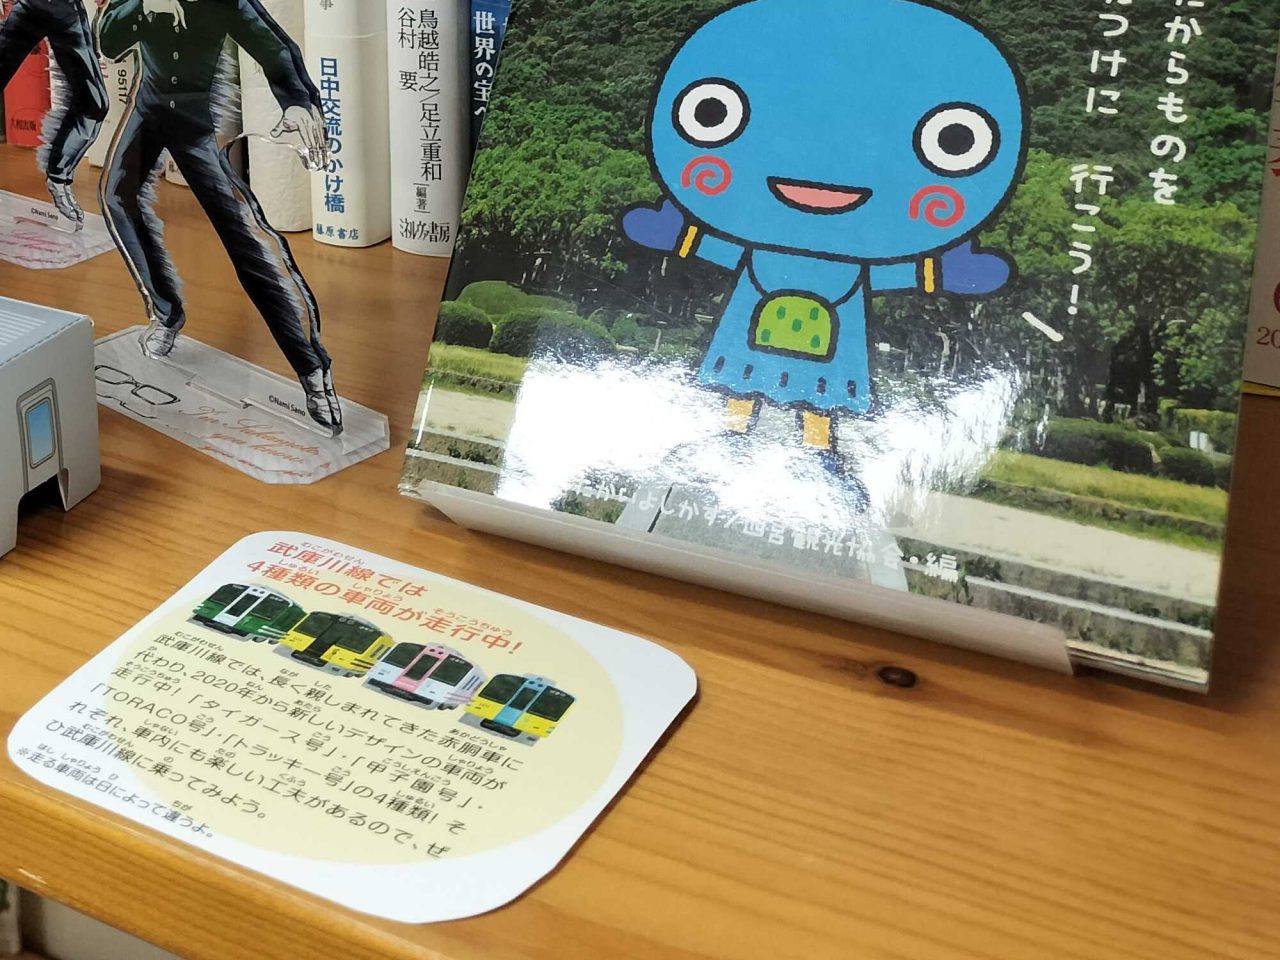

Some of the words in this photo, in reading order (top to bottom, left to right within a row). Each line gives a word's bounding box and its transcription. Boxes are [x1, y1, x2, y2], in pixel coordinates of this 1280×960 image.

[320, 57, 345, 214] 日中交流のかけ橋
[315, 223, 359, 240] 藤原書店
[1067, 163, 1114, 315] 行こう!
[290, 403, 306, 417] Sano
[266, 540, 430, 598] 武庫川線では
[300, 541, 366, 565] むこがわせん
[246, 558, 524, 656] 4種類の車両が走行中!
[432, 607, 514, 637] そうこうちゅう
[133, 648, 509, 792] 代わり、2020年から新しいデザインの車両が
[153, 633, 525, 772] 武庫川線では、長く親しまれてきた赤胴車に
[45, 719, 266, 819] ひ武庫川線に乗ってみよう。
[69, 700, 452, 859] れぞれ、車内にも楽しい工夫があるので、ぜ
